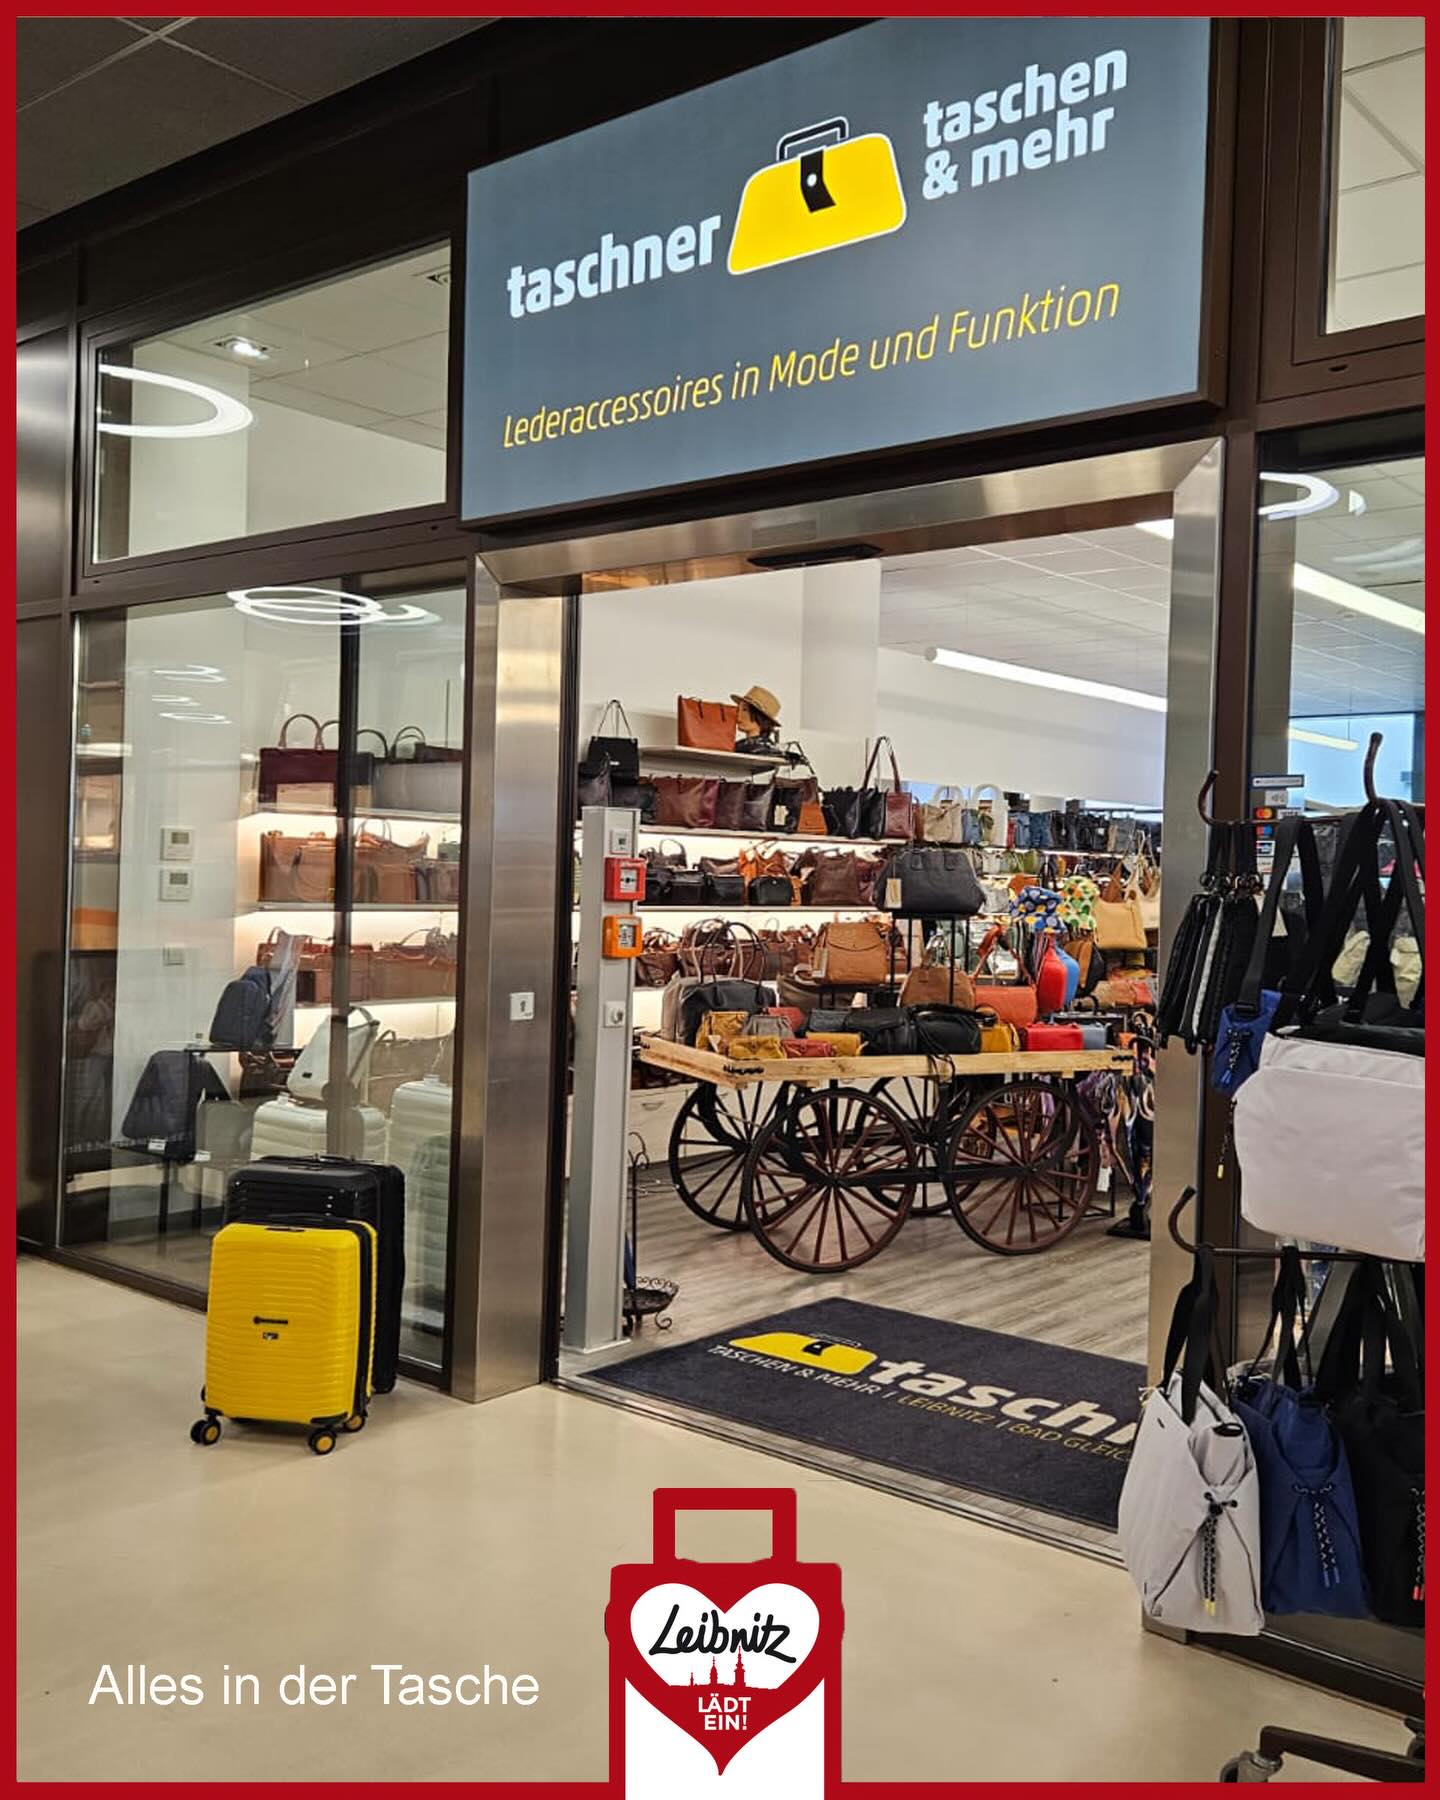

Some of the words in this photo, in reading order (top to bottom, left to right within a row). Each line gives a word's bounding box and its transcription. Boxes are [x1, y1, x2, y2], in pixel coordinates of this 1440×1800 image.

[923, 49, 1128, 148] taschen
[922, 149, 959, 201] &
[970, 106, 1116, 189] mehr
[507, 214, 722, 319] taschner
[503, 372, 724, 449] Lederaccessoires
[731, 361, 761, 401] in
[768, 338, 861, 390] Mode
[868, 315, 940, 372] und
[948, 280, 1122, 354] Funktion
[706, 1343, 799, 1375] TASCHEN
[796, 1366, 813, 1379] &
[815, 1372, 883, 1396] MEHR
[897, 1393, 997, 1425] LEIBNITZ
[1008, 1422, 1063, 1442] BAD
